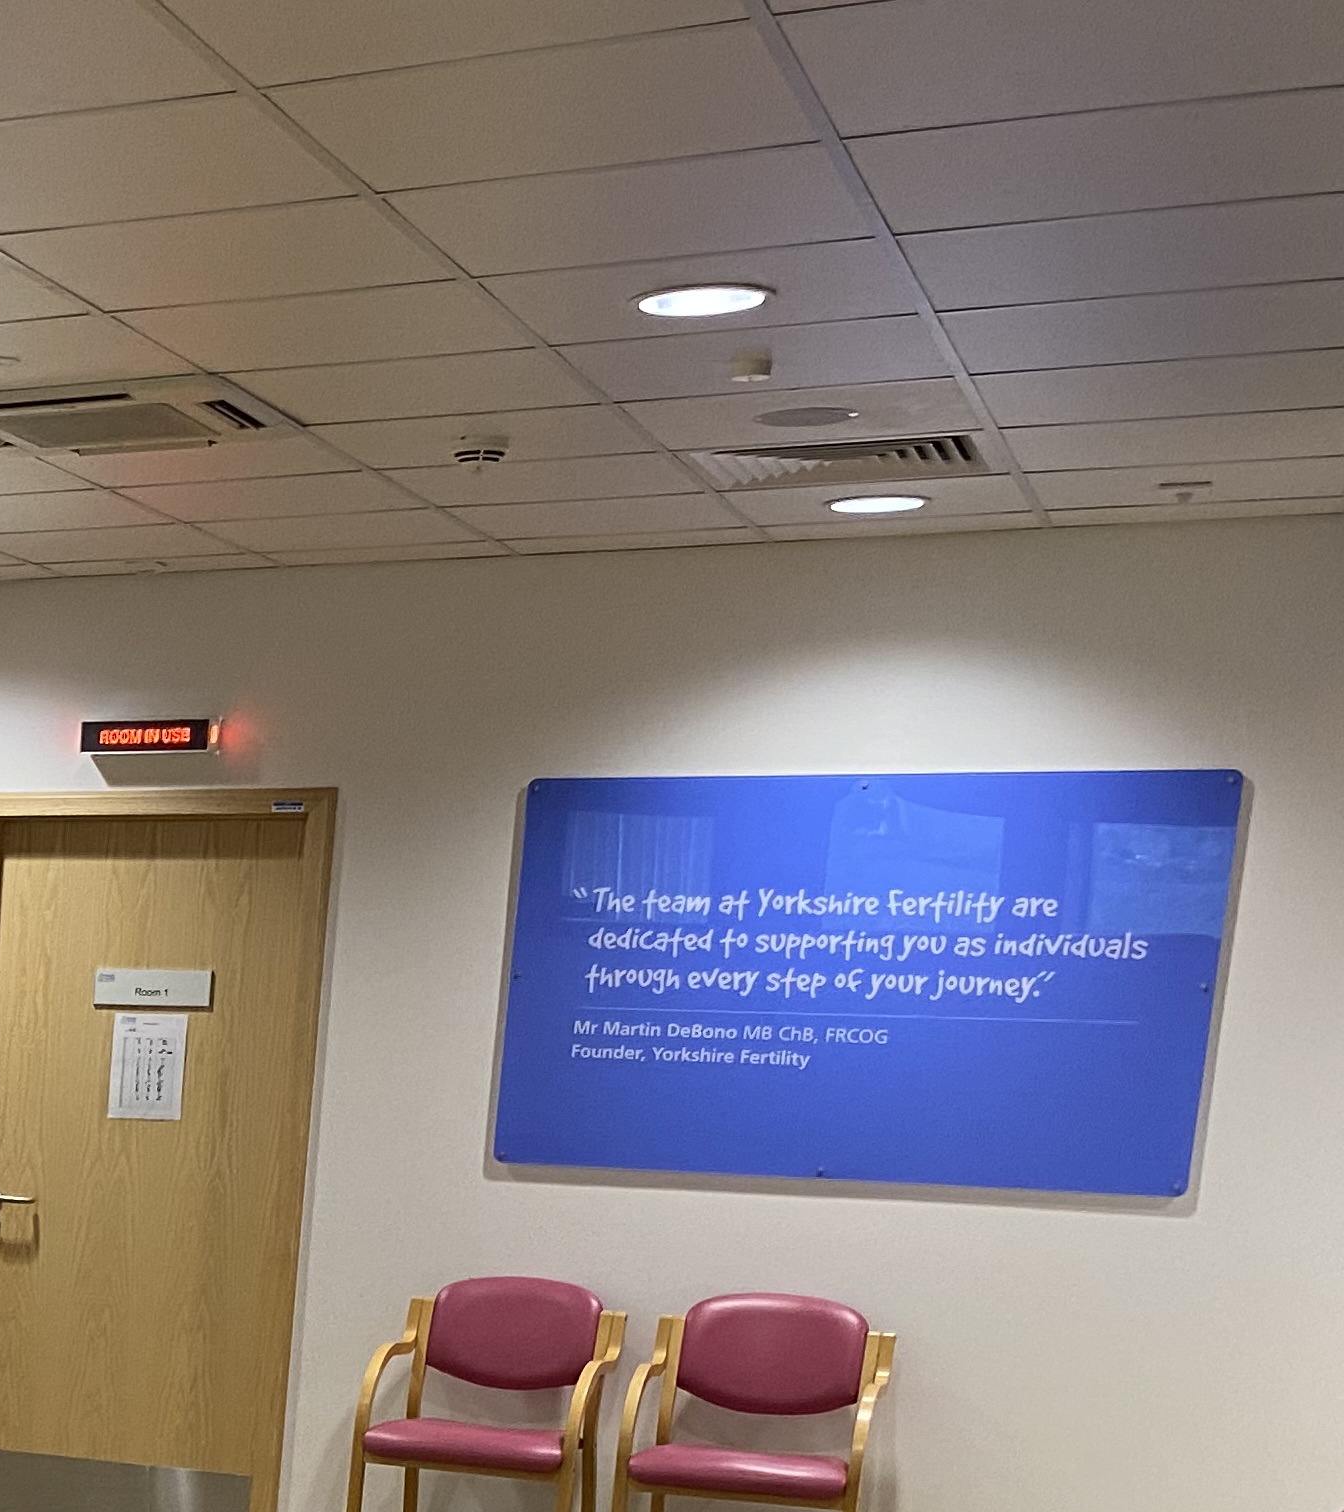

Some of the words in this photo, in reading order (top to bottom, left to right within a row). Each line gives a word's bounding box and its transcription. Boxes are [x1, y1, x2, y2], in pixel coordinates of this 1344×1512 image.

[99, 727, 143, 745] ROOM
[144, 727, 161, 744] IN
[162, 726, 191, 744] USE
[642, 889, 711, 920] team
[718, 889, 750, 921] at
[758, 888, 879, 917] Yorkshire
[887, 889, 1005, 923] Fertility
[1012, 896, 1059, 918] are
[588, 927, 714, 958] dedicated
[720, 928, 748, 959] to
[755, 930, 895, 961] supporting
[897, 933, 947, 962] you
[953, 936, 987, 957] as
[994, 932, 1149, 961] individuals
[134, 987, 161, 997] Room
[164, 988, 169, 997] 1
[584, 963, 680, 995] through
[687, 967, 760, 997] every
[765, 967, 827, 999] step
[834, 968, 864, 992] of
[865, 973, 930, 1000] your
[573, 1020, 599, 1036] Mr
[603, 1021, 662, 1038] Martin
[667, 1022, 737, 1041] DeBono
[743, 1024, 773, 1041] MB
[778, 1026, 819, 1045] ChB,
[825, 1027, 889, 1045] FRCOG
[571, 1044, 646, 1063] Founder,
[652, 1046, 734, 1065] Yorkshire
[740, 1049, 811, 1071] Fertility
